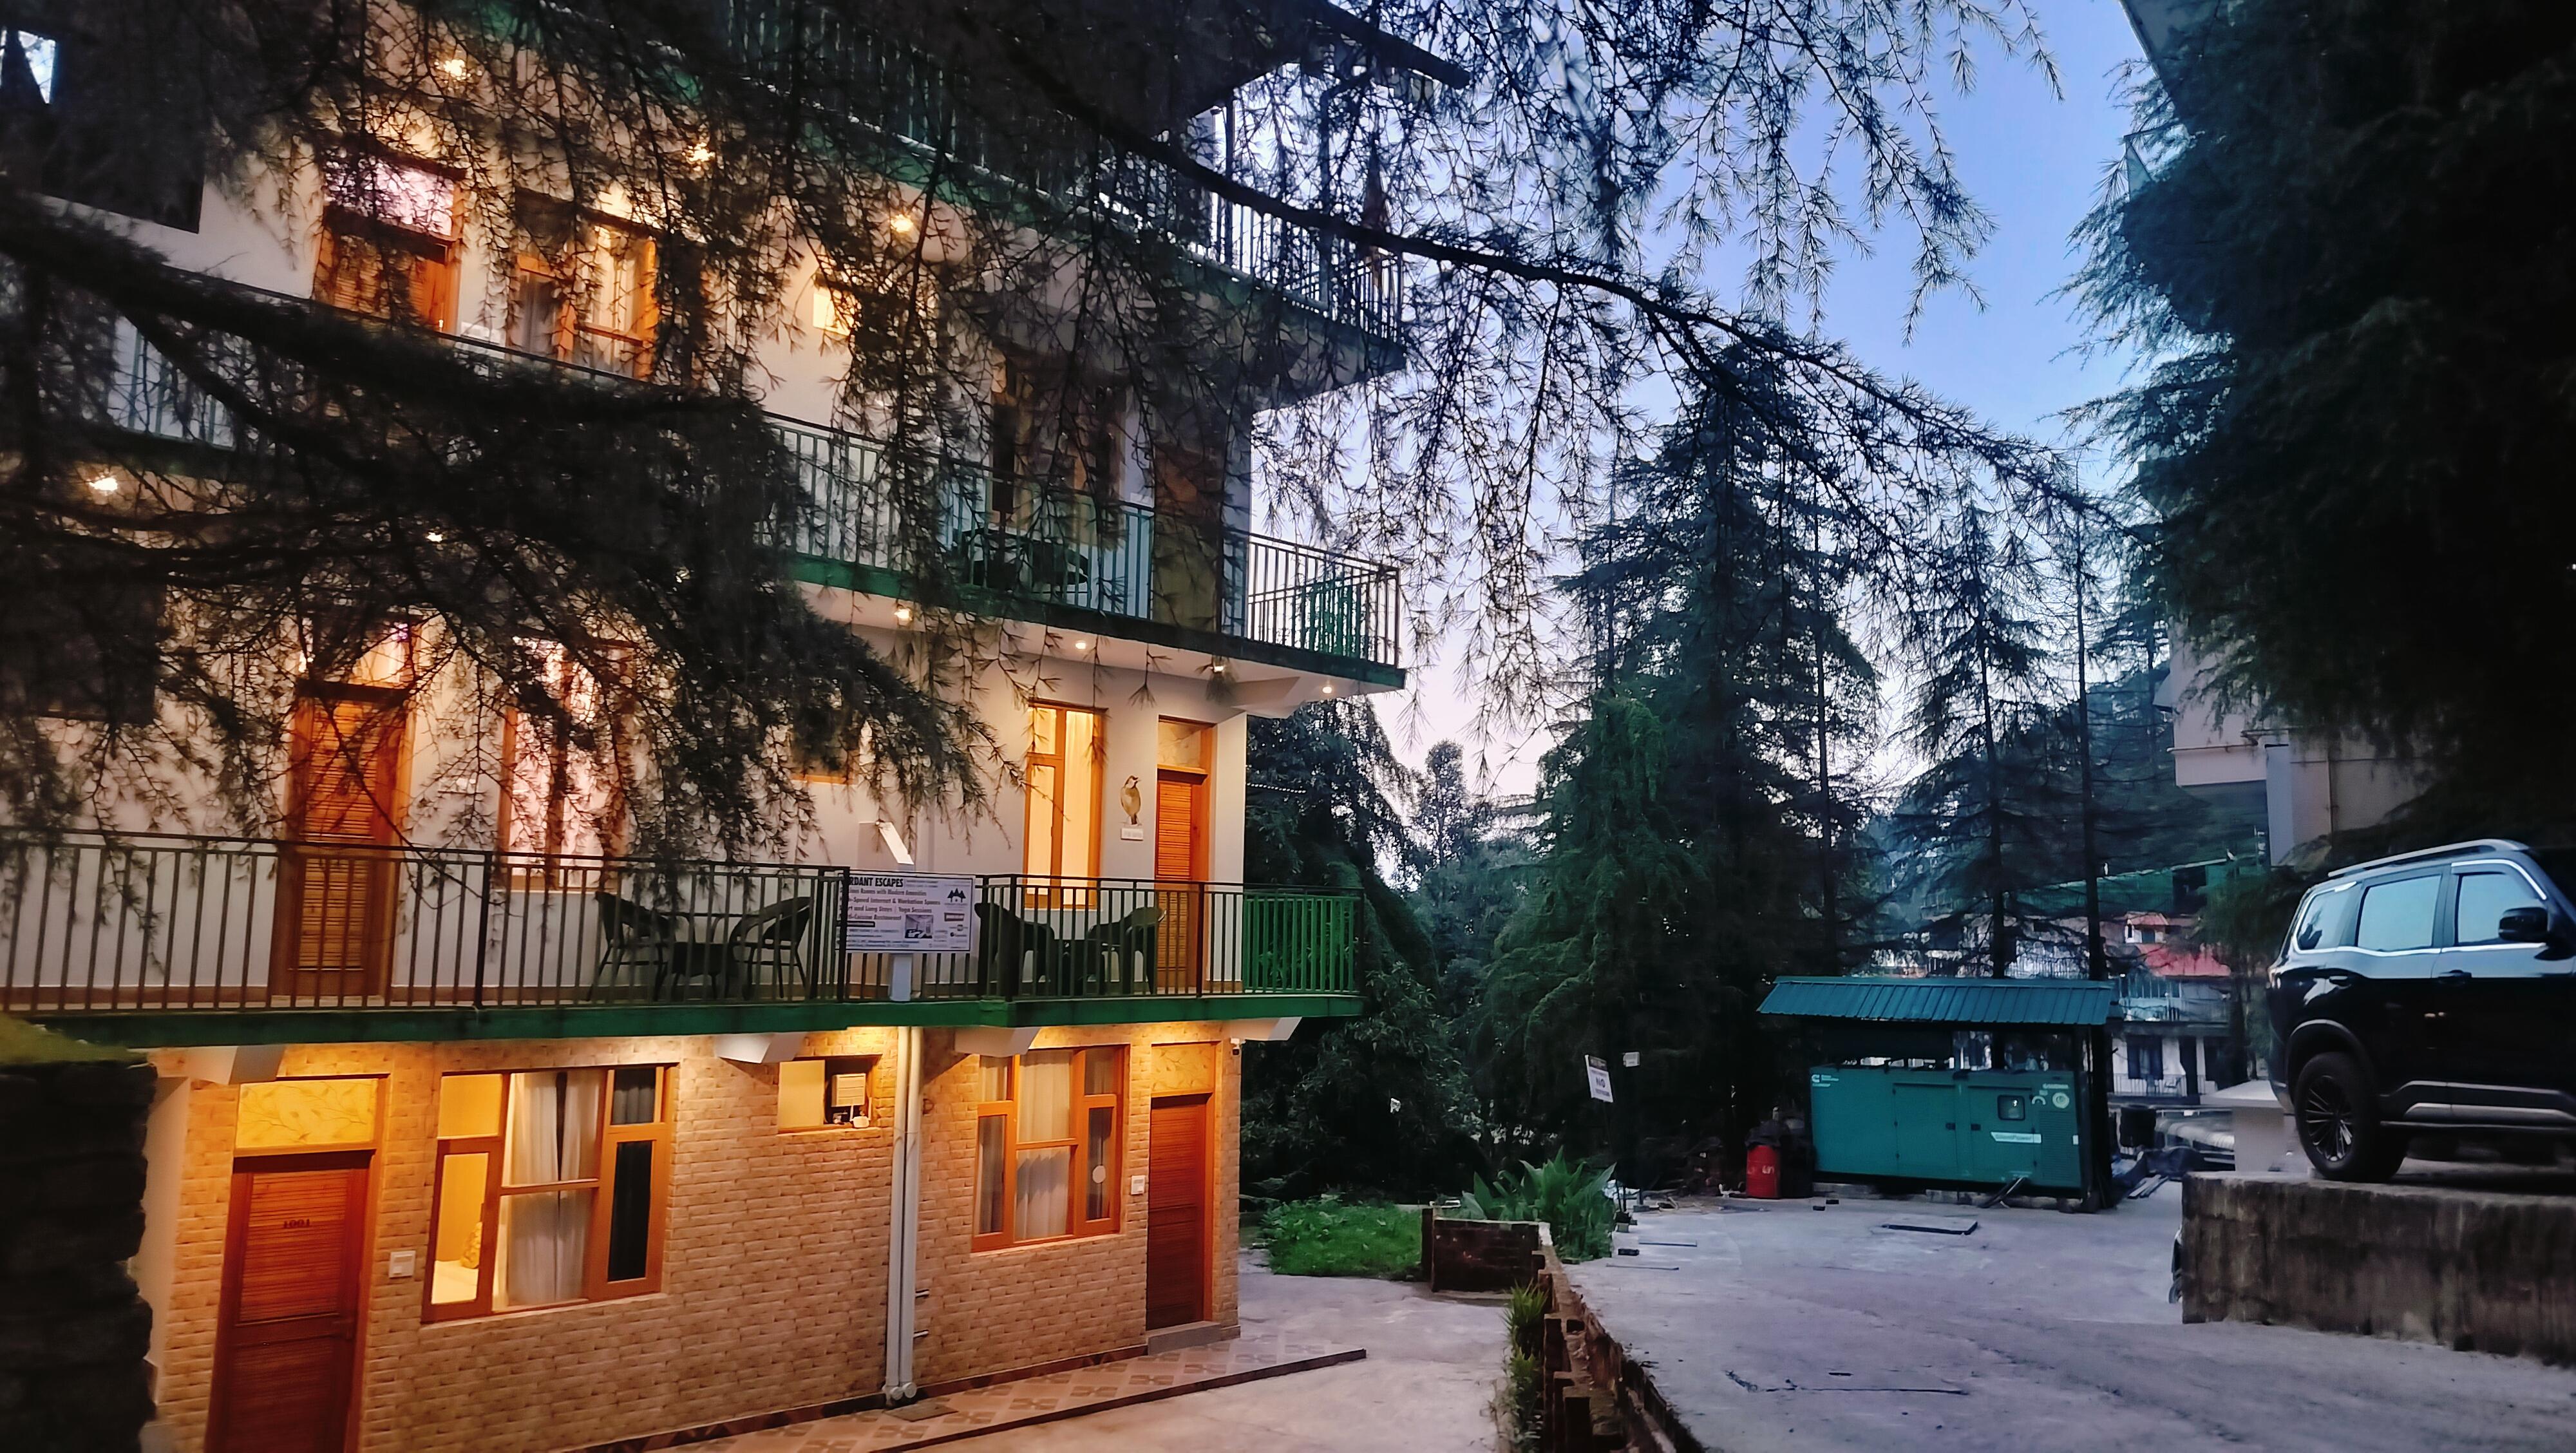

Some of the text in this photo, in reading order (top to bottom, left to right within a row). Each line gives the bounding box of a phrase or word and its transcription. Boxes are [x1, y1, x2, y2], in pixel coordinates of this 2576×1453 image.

[848, 877, 873, 886] RDANT
[875, 878, 904, 888] ESCAPES
[1596, 1076, 1605, 1088] NO
[283, 1219, 310, 1228] 1001
